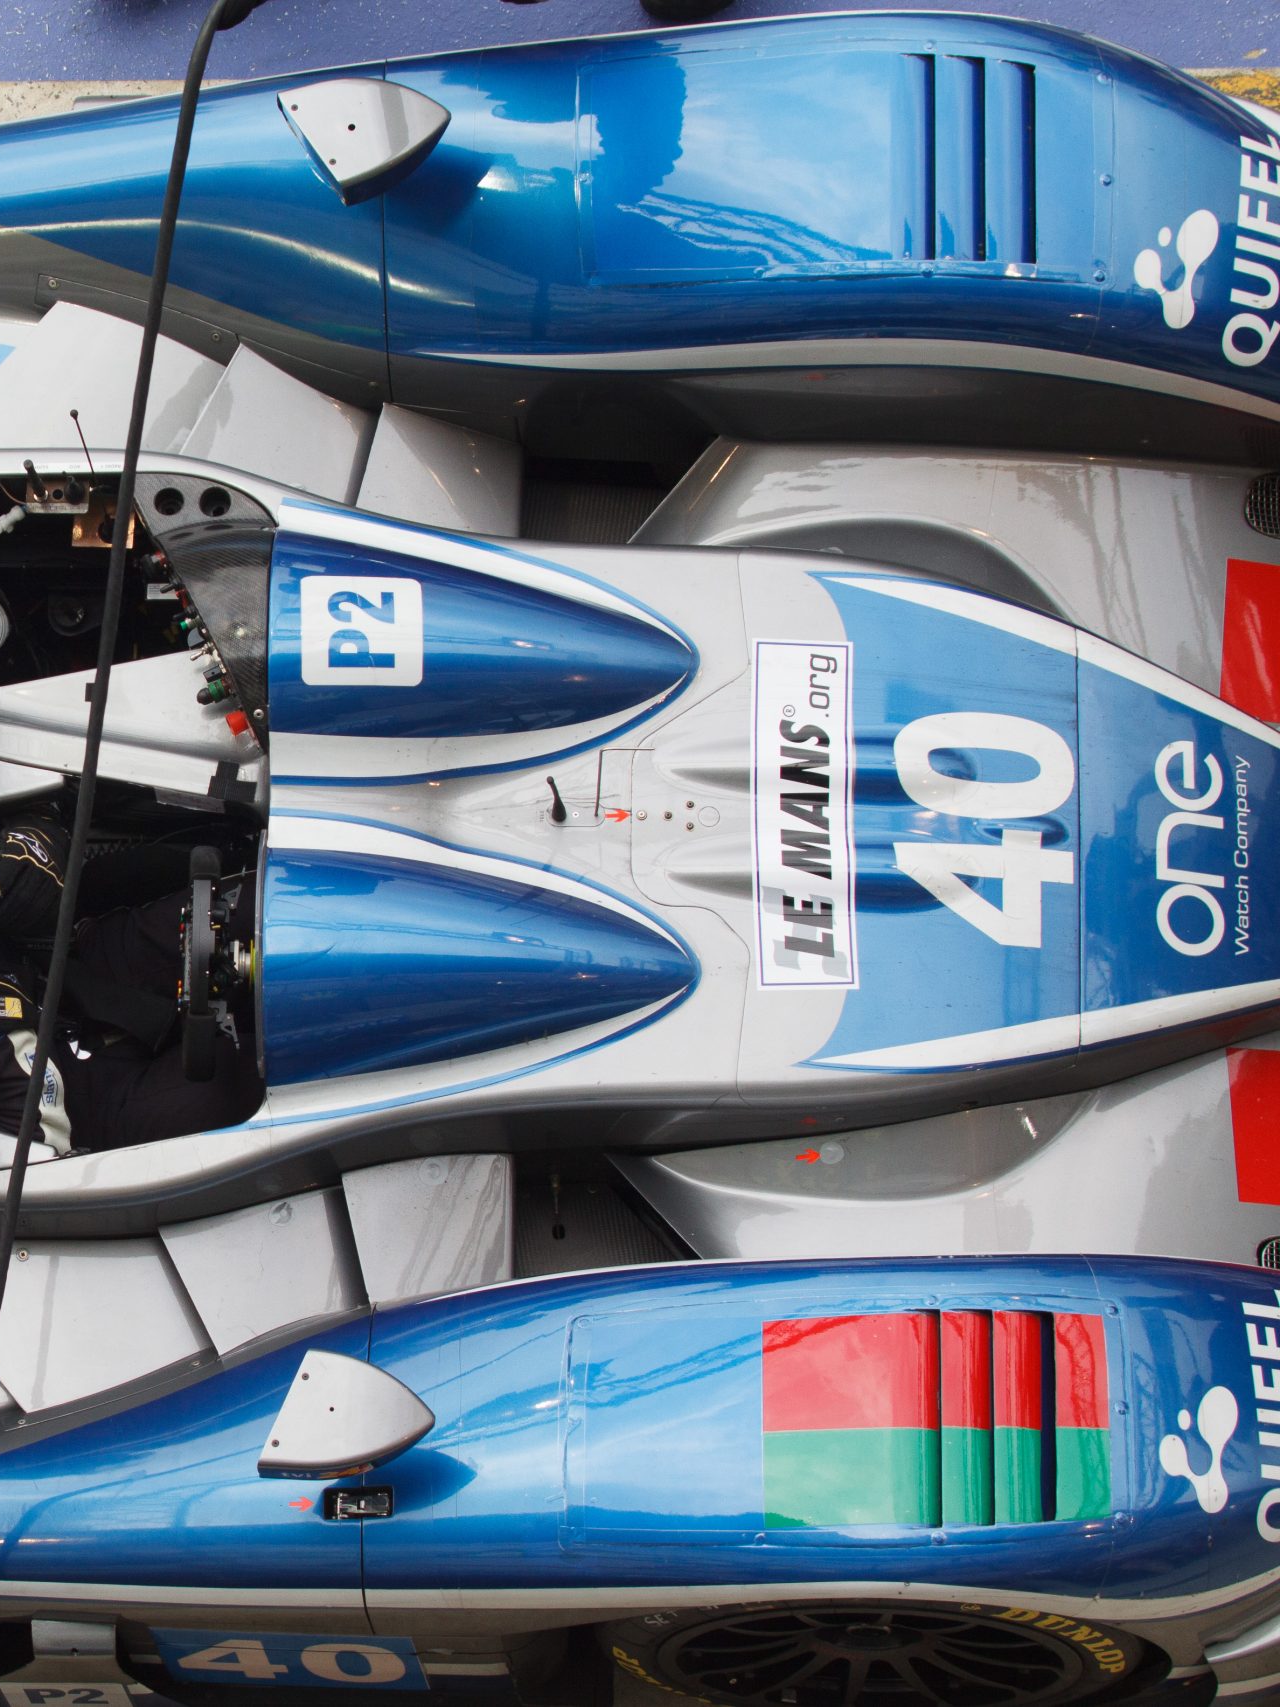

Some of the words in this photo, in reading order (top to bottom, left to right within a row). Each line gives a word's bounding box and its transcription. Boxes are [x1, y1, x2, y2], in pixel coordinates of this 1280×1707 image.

[327, 591, 396, 668] P2
[893, 711, 1076, 949] 40
[1154, 740, 1224, 957] one
[1234, 755, 1252, 869] Company
[782, 894, 836, 958] LE
[1234, 879, 1250, 956] Watch
[177, 1638, 406, 1684] 40
[990, 1607, 1128, 1675] DUNLOP
[20, 1687, 110, 1704] P2
